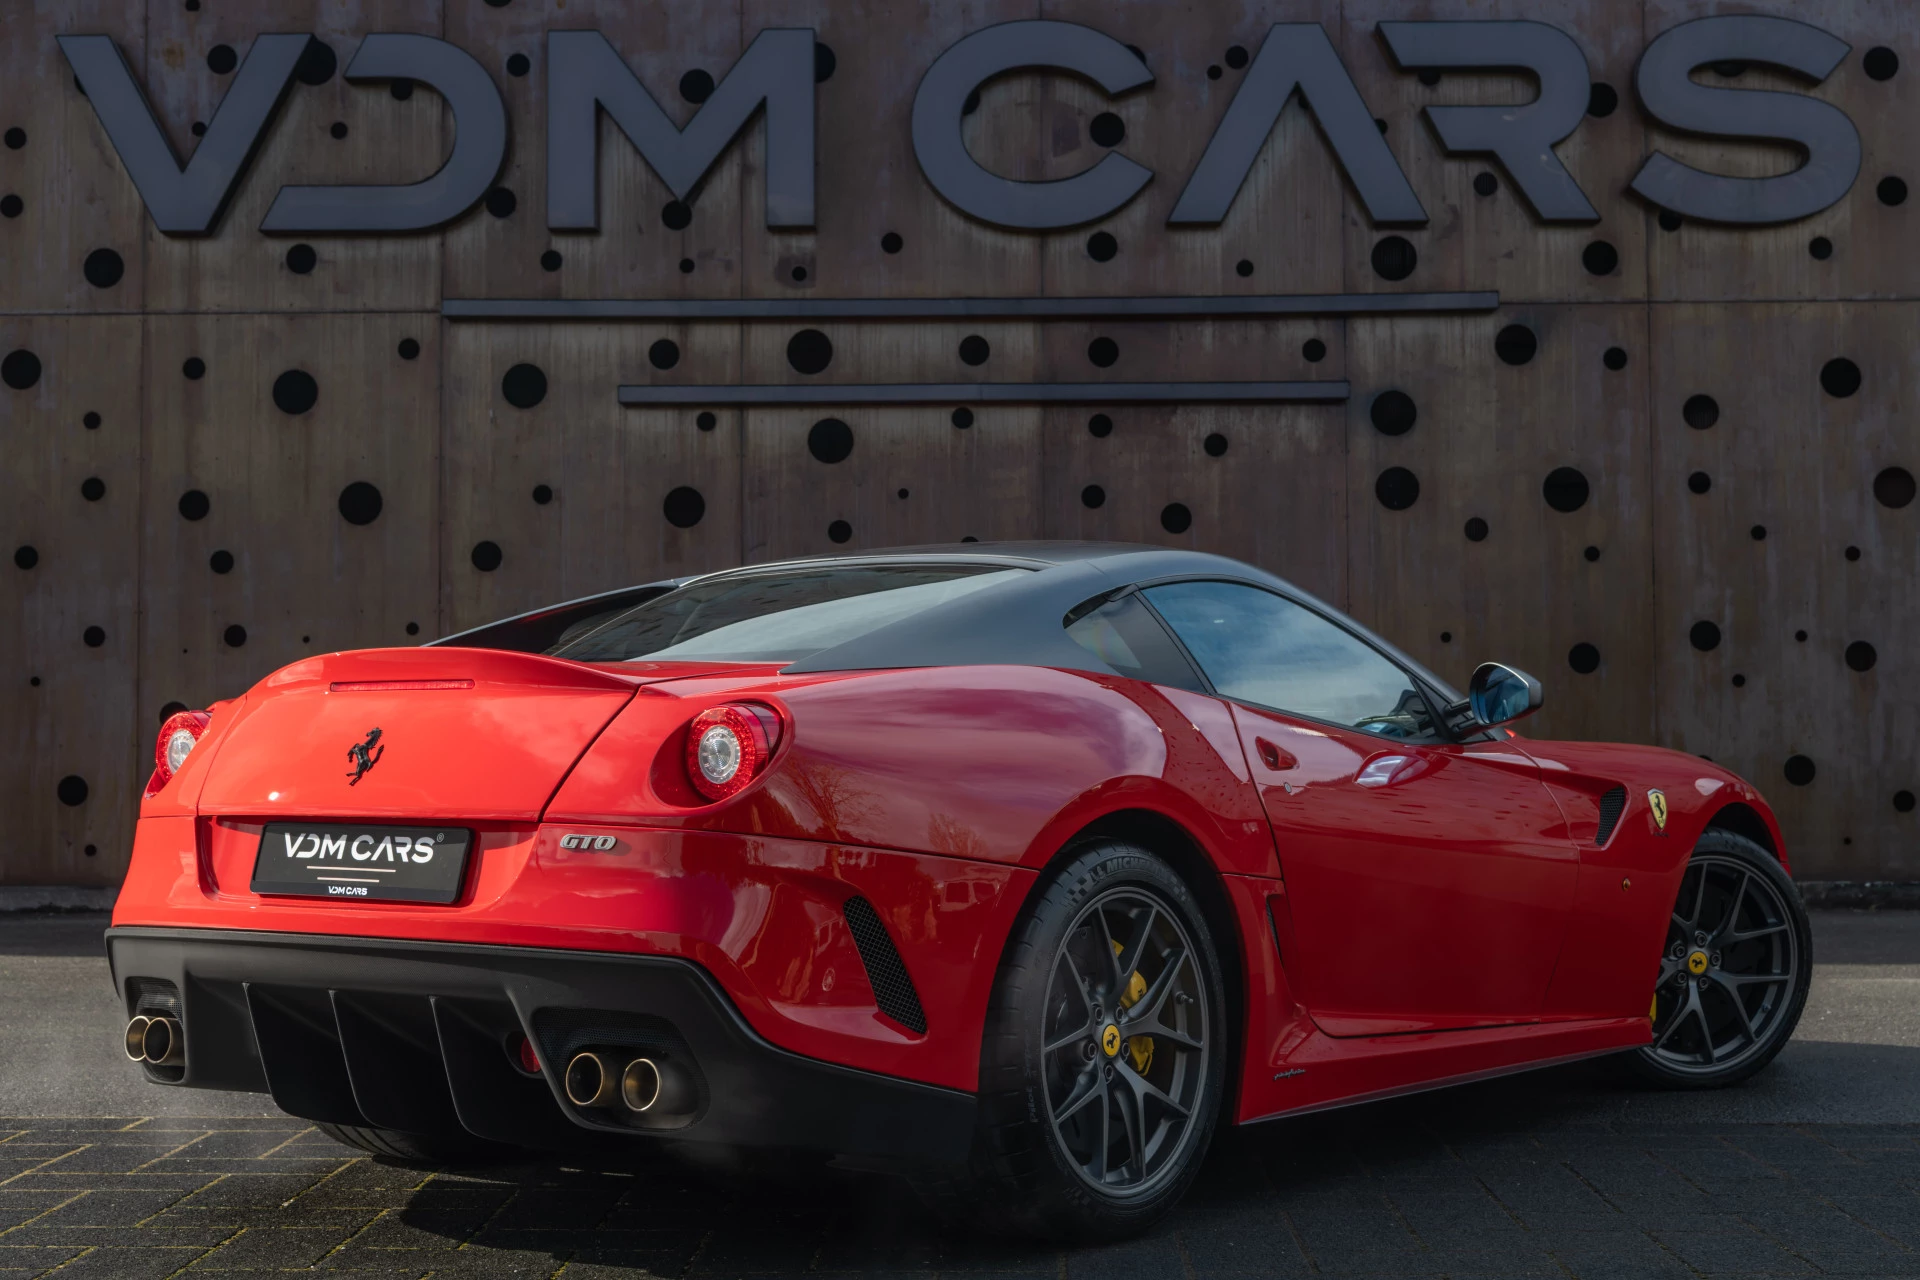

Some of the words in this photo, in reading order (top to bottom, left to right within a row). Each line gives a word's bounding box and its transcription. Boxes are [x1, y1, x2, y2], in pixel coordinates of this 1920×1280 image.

[56, 28, 816, 236] VDM
[910, 14, 1862, 229] CARS
[284, 832, 348, 860] VDM
[560, 833, 616, 850] GTO
[328, 886, 345, 895] VDM
[346, 887, 368, 896] CARS
